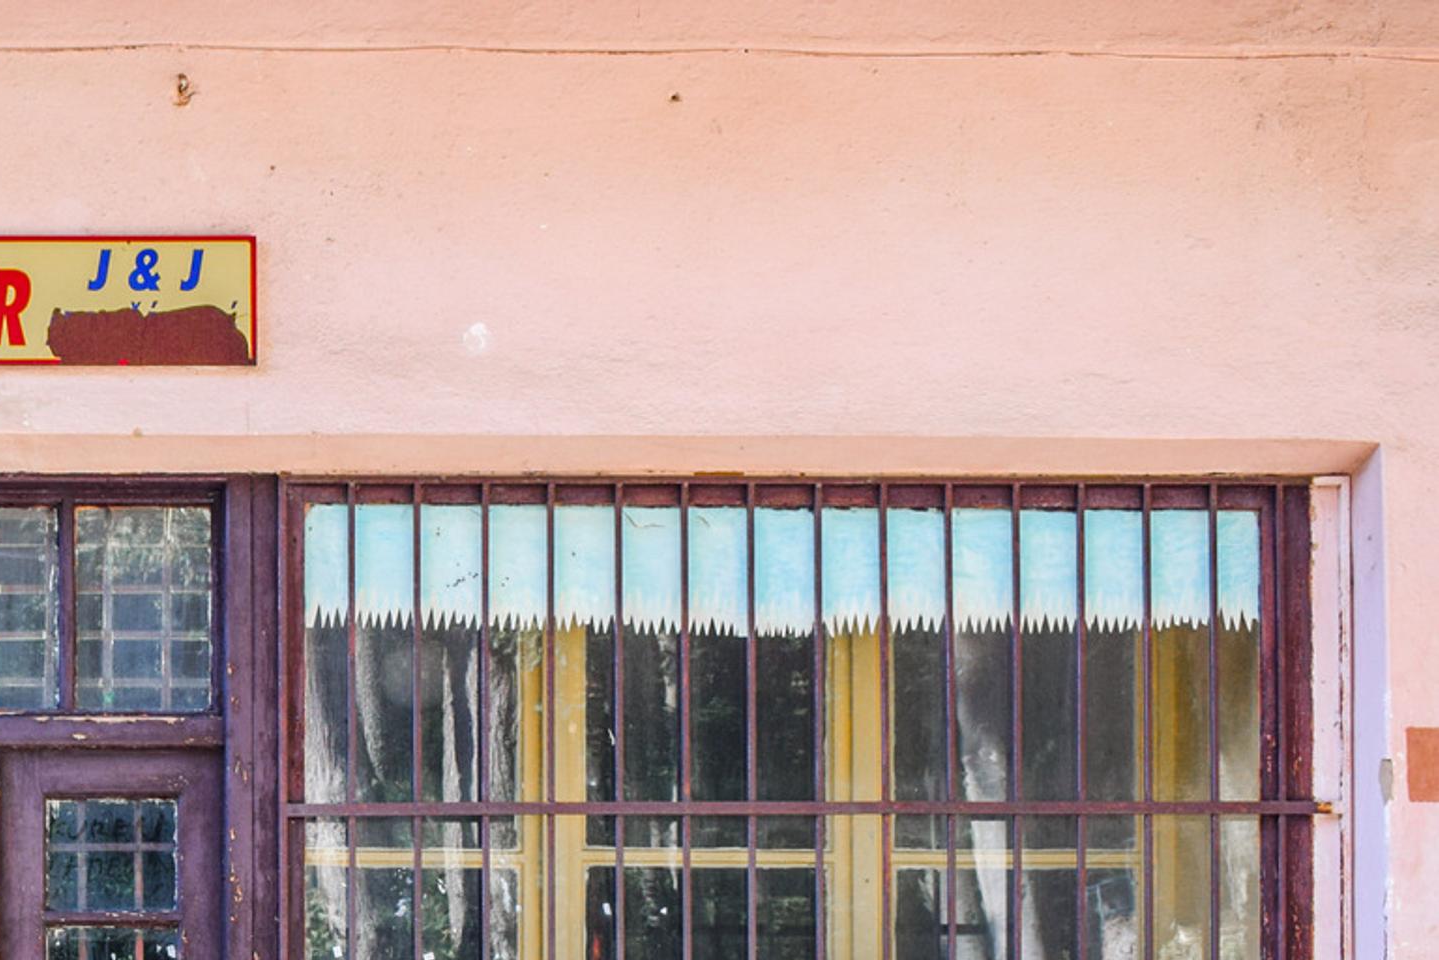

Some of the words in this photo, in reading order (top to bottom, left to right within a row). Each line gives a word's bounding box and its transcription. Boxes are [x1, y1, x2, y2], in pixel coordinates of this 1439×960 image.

[87, 248, 111, 291] J
[128, 248, 160, 291] &
[179, 248, 204, 291] J
